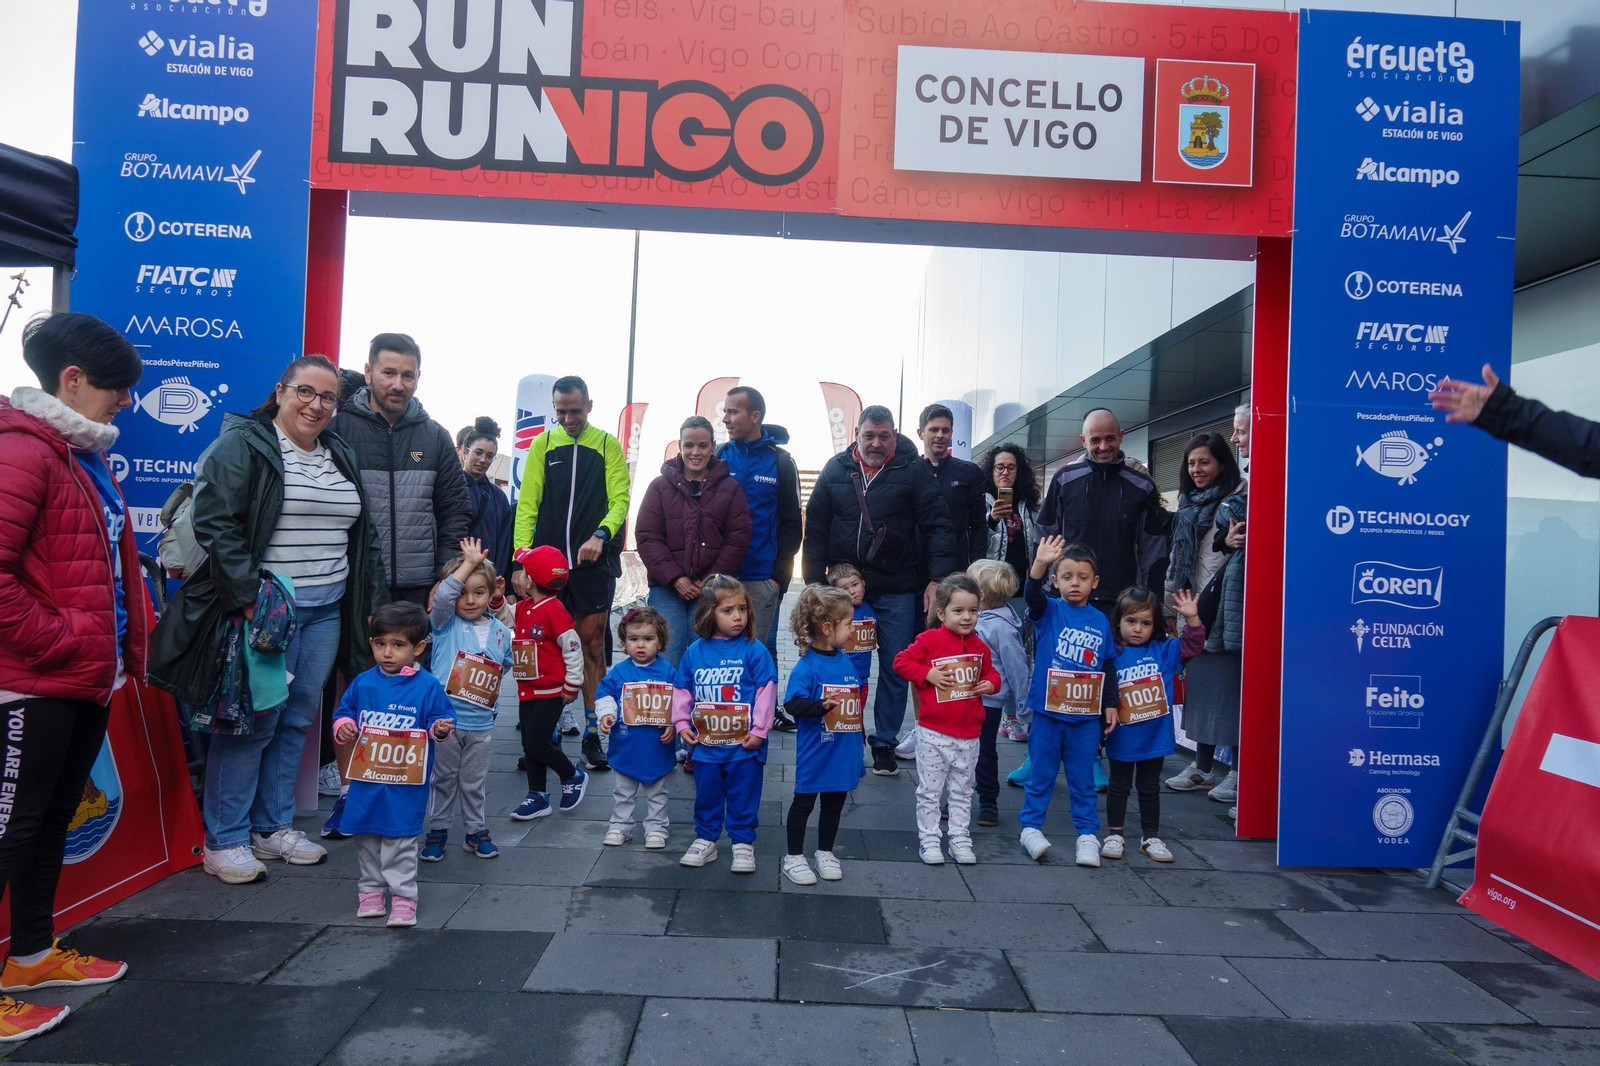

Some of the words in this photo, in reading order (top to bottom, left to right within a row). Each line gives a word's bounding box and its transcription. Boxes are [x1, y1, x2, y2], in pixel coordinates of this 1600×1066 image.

[347, 0, 574, 77] RUN
[857, 6, 969, 39] Subida
[981, 13, 1021, 41] Ao
[1034, 15, 1139, 47] Castro
[1169, 23, 1227, 53] 5+5
[1240, 27, 1280, 55] Do
[168, 34, 254, 61] vialia
[678, 37, 749, 73] Vigo
[166, 62, 211, 76] ESTACIÓN
[214, 65, 227, 76] DE
[229, 66, 254, 78] VIGO
[1347, 69, 1455, 83] asociación
[915, 73, 1123, 113] CONCELLO
[138, 93, 249, 126] Alcampo
[1383, 100, 1463, 126] vialia
[939, 114, 989, 146] DE
[1003, 117, 1098, 151] VIGO
[1382, 127, 1424, 140] ESTACIÓN
[1426, 130, 1439, 140] DE
[1441, 131, 1463, 142] VIGO
[124, 152, 157, 162] GRUPO
[120, 161, 224, 182] BOTAMAVI
[1356, 157, 1460, 187] Alcampo
[851, 177, 967, 209] Cáncer
[996, 185, 1065, 220] Vigo
[1157, 193, 1191, 220] La
[1205, 195, 1236, 221] 21
[1343, 214, 1375, 223] GRUPO
[158, 220, 252, 239] COTERENA
[1340, 222, 1437, 242] BOTAMAVI
[135, 285, 233, 298] SEGUROS
[1376, 279, 1463, 297] COTERENA
[124, 314, 244, 340] MAROSA
[1355, 342, 1446, 353] SEGUROS
[141, 358, 220, 370] escadosPérezPiñeiro
[1356, 412, 1435, 423] PescadosPérezPiñeiro
[1357, 510, 1471, 528] TECHNOLOGY
[1384, 527, 1423, 535] INFORMÁTICOS
[1372, 622, 1444, 637] FUNDACIÓN
[1058, 627, 1103, 651] CORRER
[1372, 636, 1412, 649] CELTA
[468, 667, 499, 692] 1013
[694, 667, 744, 685] CORRER
[950, 666, 979, 684] 003
[458, 687, 490, 705] Alcampo
[1065, 683, 1093, 700] 1011
[1124, 685, 1162, 708] 1002
[1365, 686, 1425, 709] Feito
[635, 693, 672, 710] 1007
[1058, 703, 1091, 714] Alcampo
[634, 714, 667, 724] Alcampo
[703, 714, 742, 732] 1005
[1129, 708, 1162, 722] Alcampo
[7, 707, 26, 742] YOU
[3, 744, 23, 780] ARE
[370, 741, 417, 765] 1006
[1368, 750, 1441, 767] Hermasa
[362, 768, 408, 783] Alcampo
[1368, 768, 1391, 776] Canning
[1391, 769, 1421, 777] technology
[1377, 837, 1410, 845] VODEA
[1487, 887, 1517, 909] vigo.org
